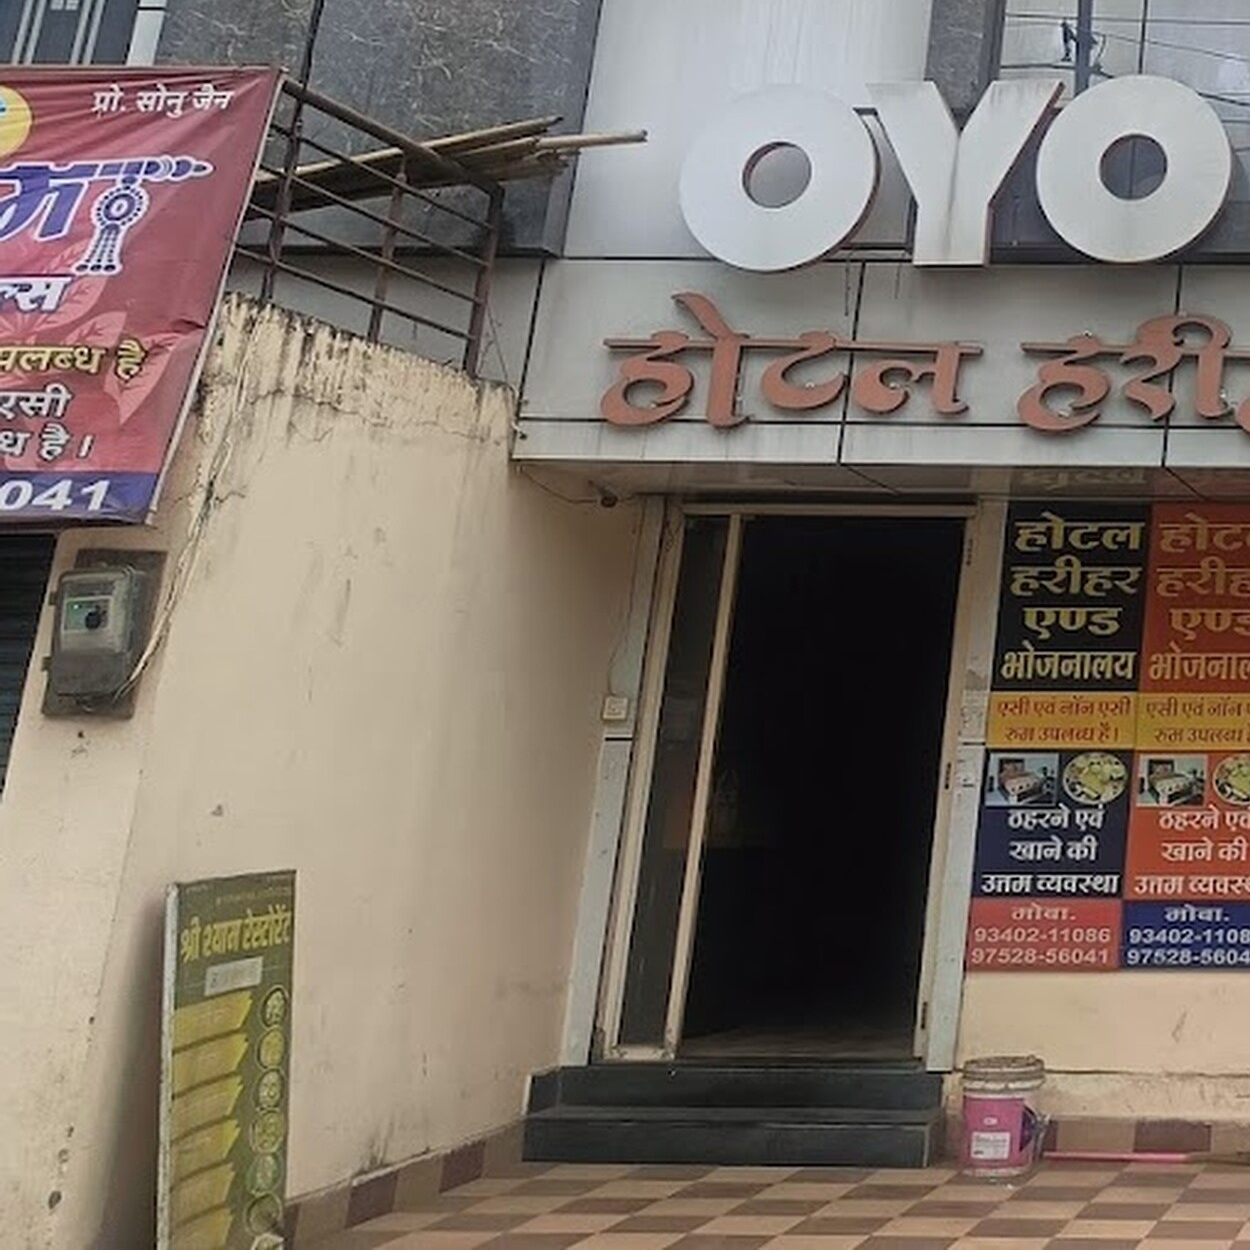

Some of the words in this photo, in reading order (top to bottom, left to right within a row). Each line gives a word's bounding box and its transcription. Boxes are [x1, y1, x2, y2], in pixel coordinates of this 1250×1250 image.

[91, 84, 126, 118] प्रो.
[192, 83, 234, 111] जैन
[679, 75, 1233, 272] OYO
[116, 339, 147, 381] है
[600, 291, 984, 430] होटल
[39, 422, 70, 461] है
[0, 479, 110, 512] 041
[1014, 511, 1145, 551] होटल
[1010, 554, 1143, 597] हरीहर
[1023, 607, 1123, 640] एण्ड
[1000, 640, 1137, 680] भोजनालय
[1008, 803, 1068, 829] ठहरने
[1160, 805, 1219, 830] ठहरने
[1009, 834, 1061, 861] खाने
[1067, 835, 1098, 861] की
[1161, 837, 1213, 862] खाने
[1218, 836, 1249, 862] की
[1037, 873, 1119, 893] व्यवस्था
[974, 928, 1111, 944] 93402-11086
[971, 948, 1108, 964] 97528-56041
